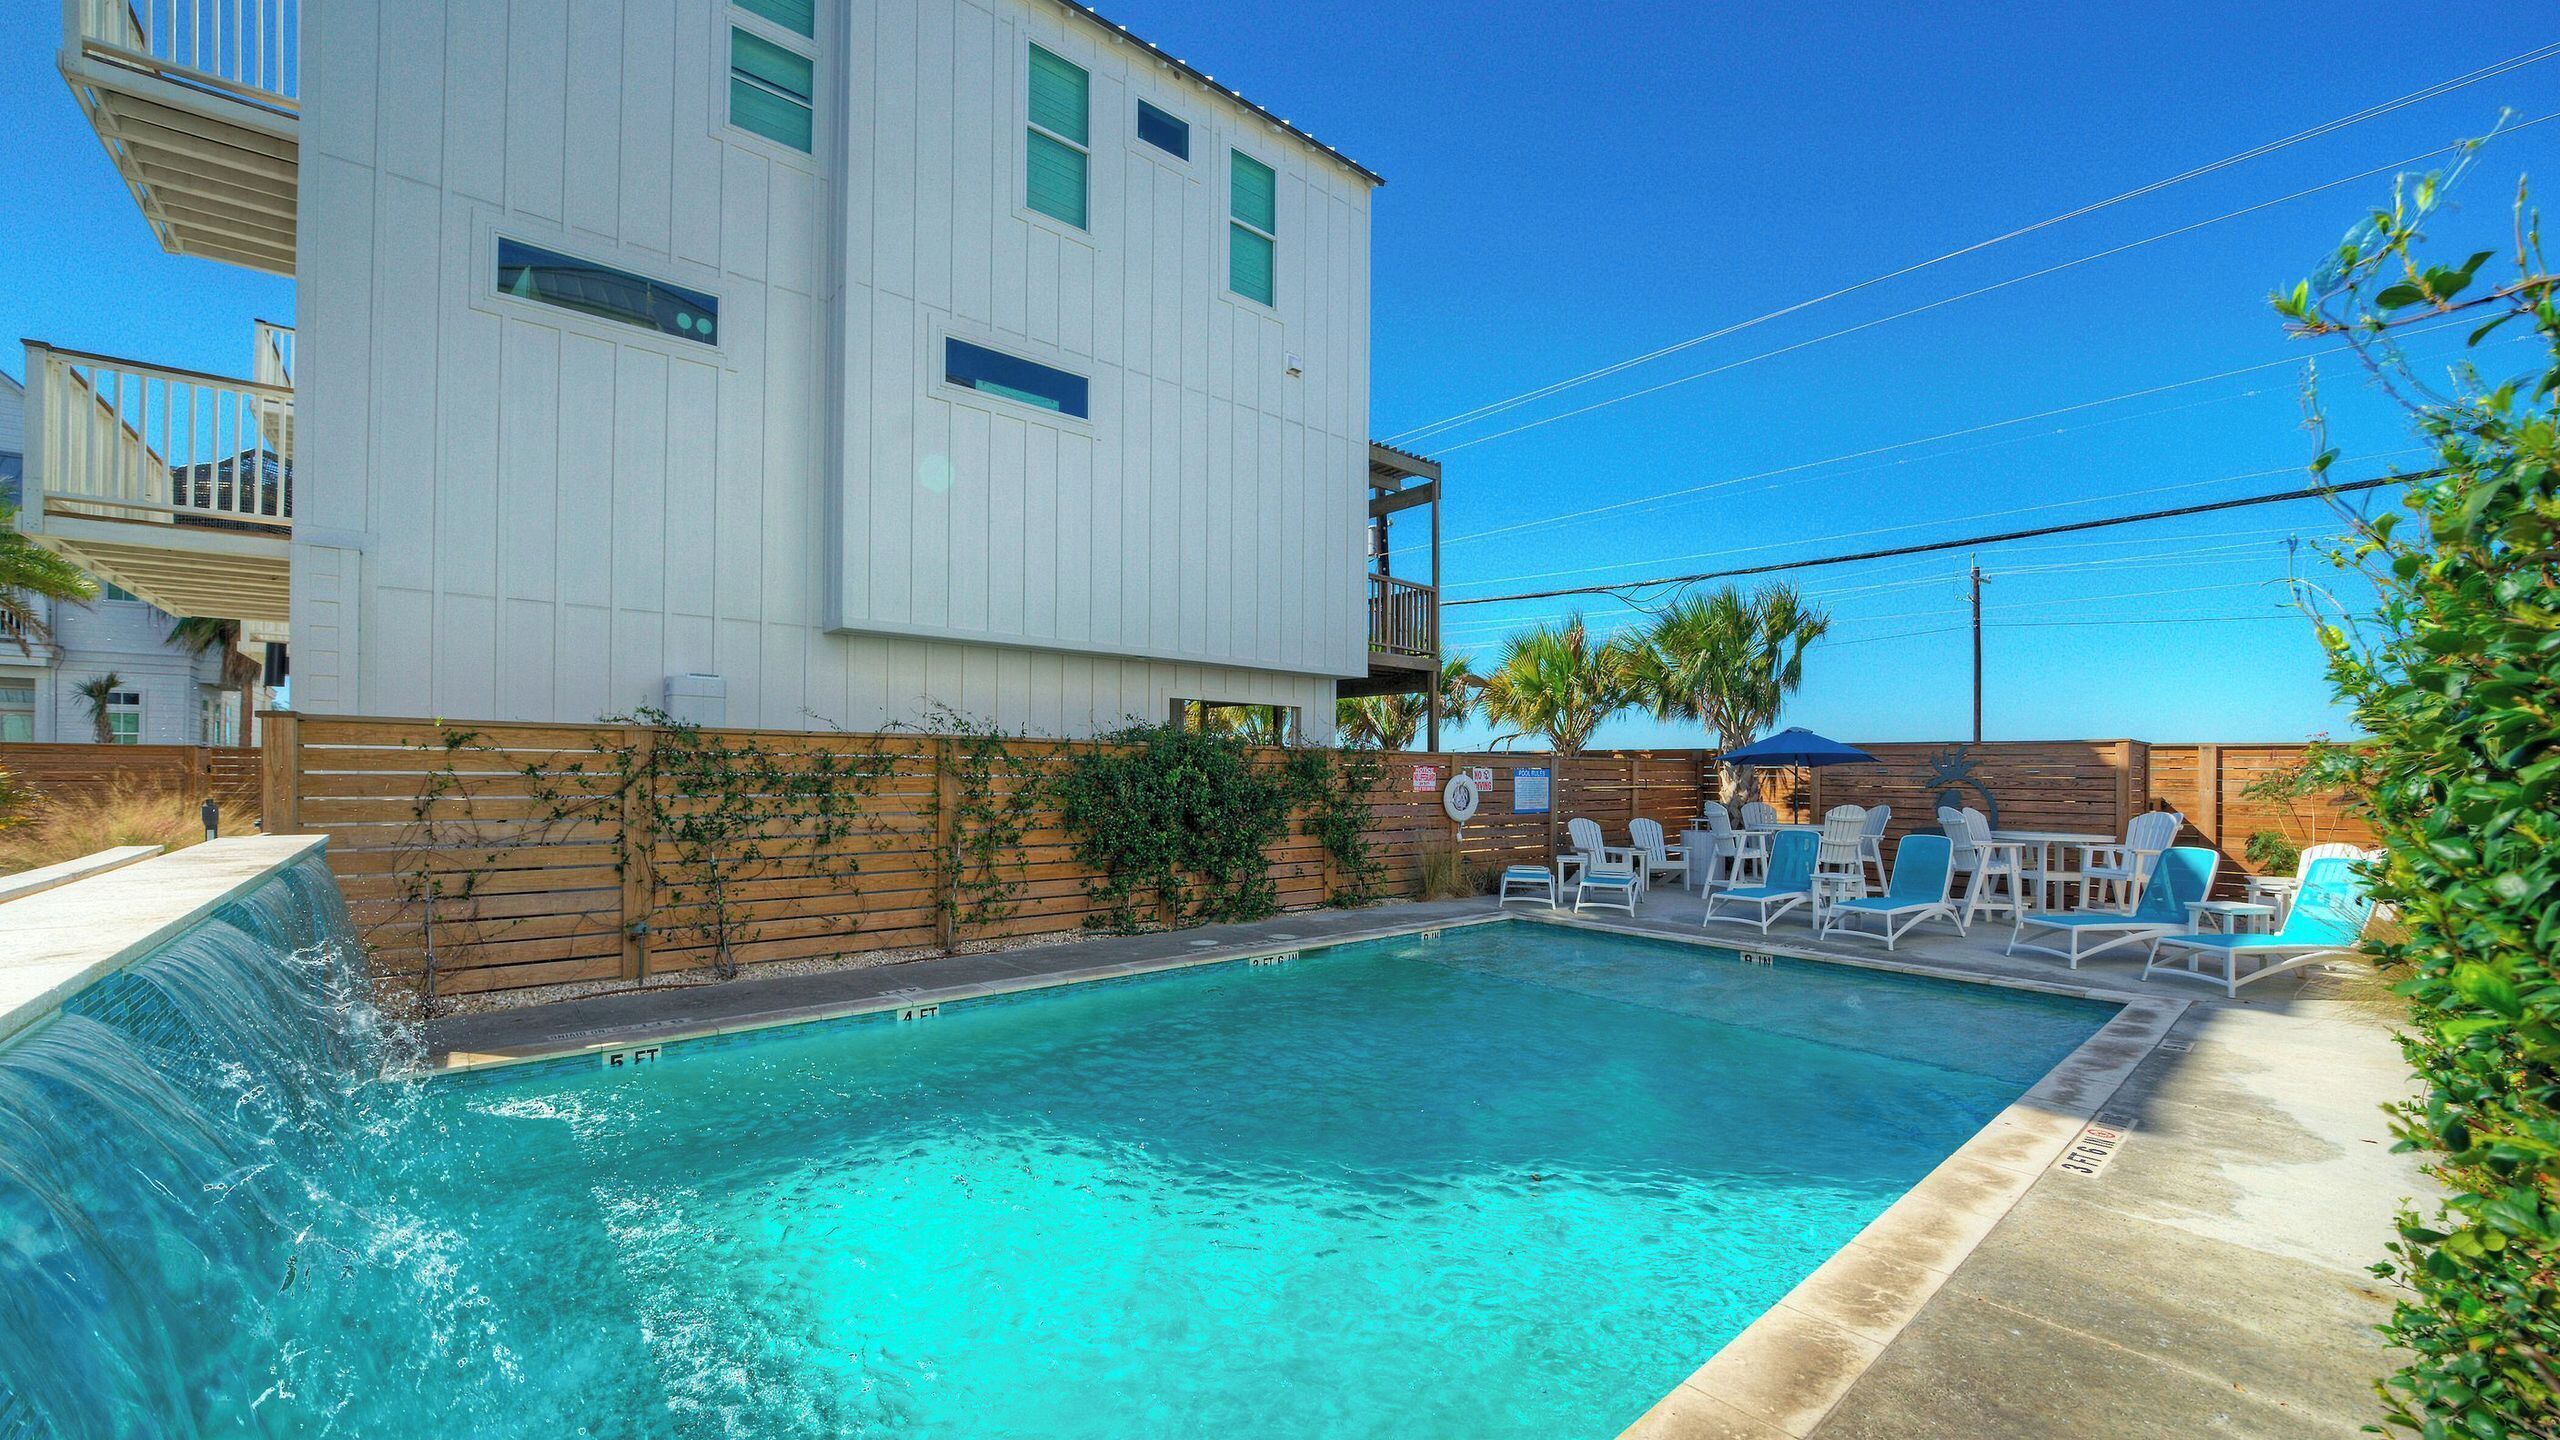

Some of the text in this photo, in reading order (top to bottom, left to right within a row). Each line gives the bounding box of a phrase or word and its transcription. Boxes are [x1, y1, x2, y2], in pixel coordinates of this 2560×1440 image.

[1474, 770, 1482, 780] NO
[1758, 956, 1771, 966] IN
[920, 1007, 938, 1019] FT
[610, 1048, 659, 1068] 5 FT
[2082, 1136, 2116, 1149] IN
[2077, 1146, 2108, 1156] 6
[2066, 1151, 2102, 1168] FT
[2061, 1163, 2094, 1174] 3
